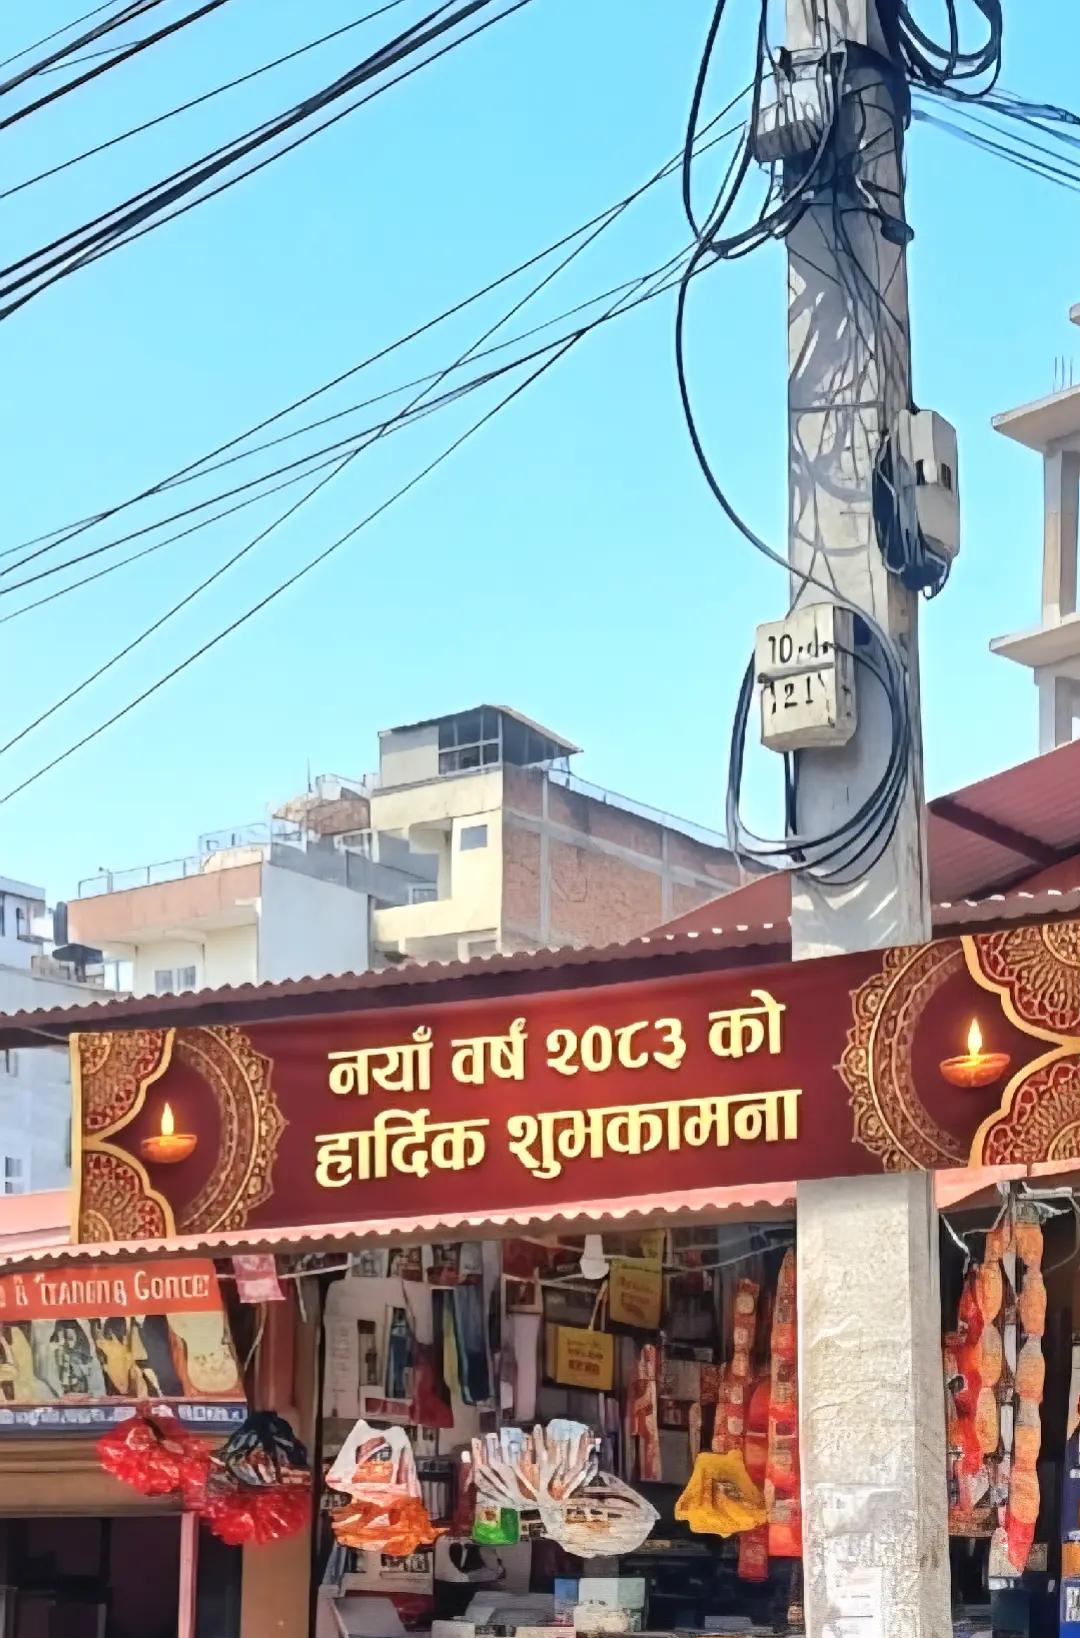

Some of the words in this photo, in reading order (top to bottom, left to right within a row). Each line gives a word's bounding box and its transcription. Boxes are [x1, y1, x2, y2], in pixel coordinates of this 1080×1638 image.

[328, 1024, 434, 1096] नयाँ
[451, 1017, 528, 1085] वर्ष
[546, 1018, 687, 1077] २०८३
[708, 989, 786, 1059] को
[314, 1108, 490, 1188] हार्दिक
[507, 1088, 803, 1180] शुभकामना
